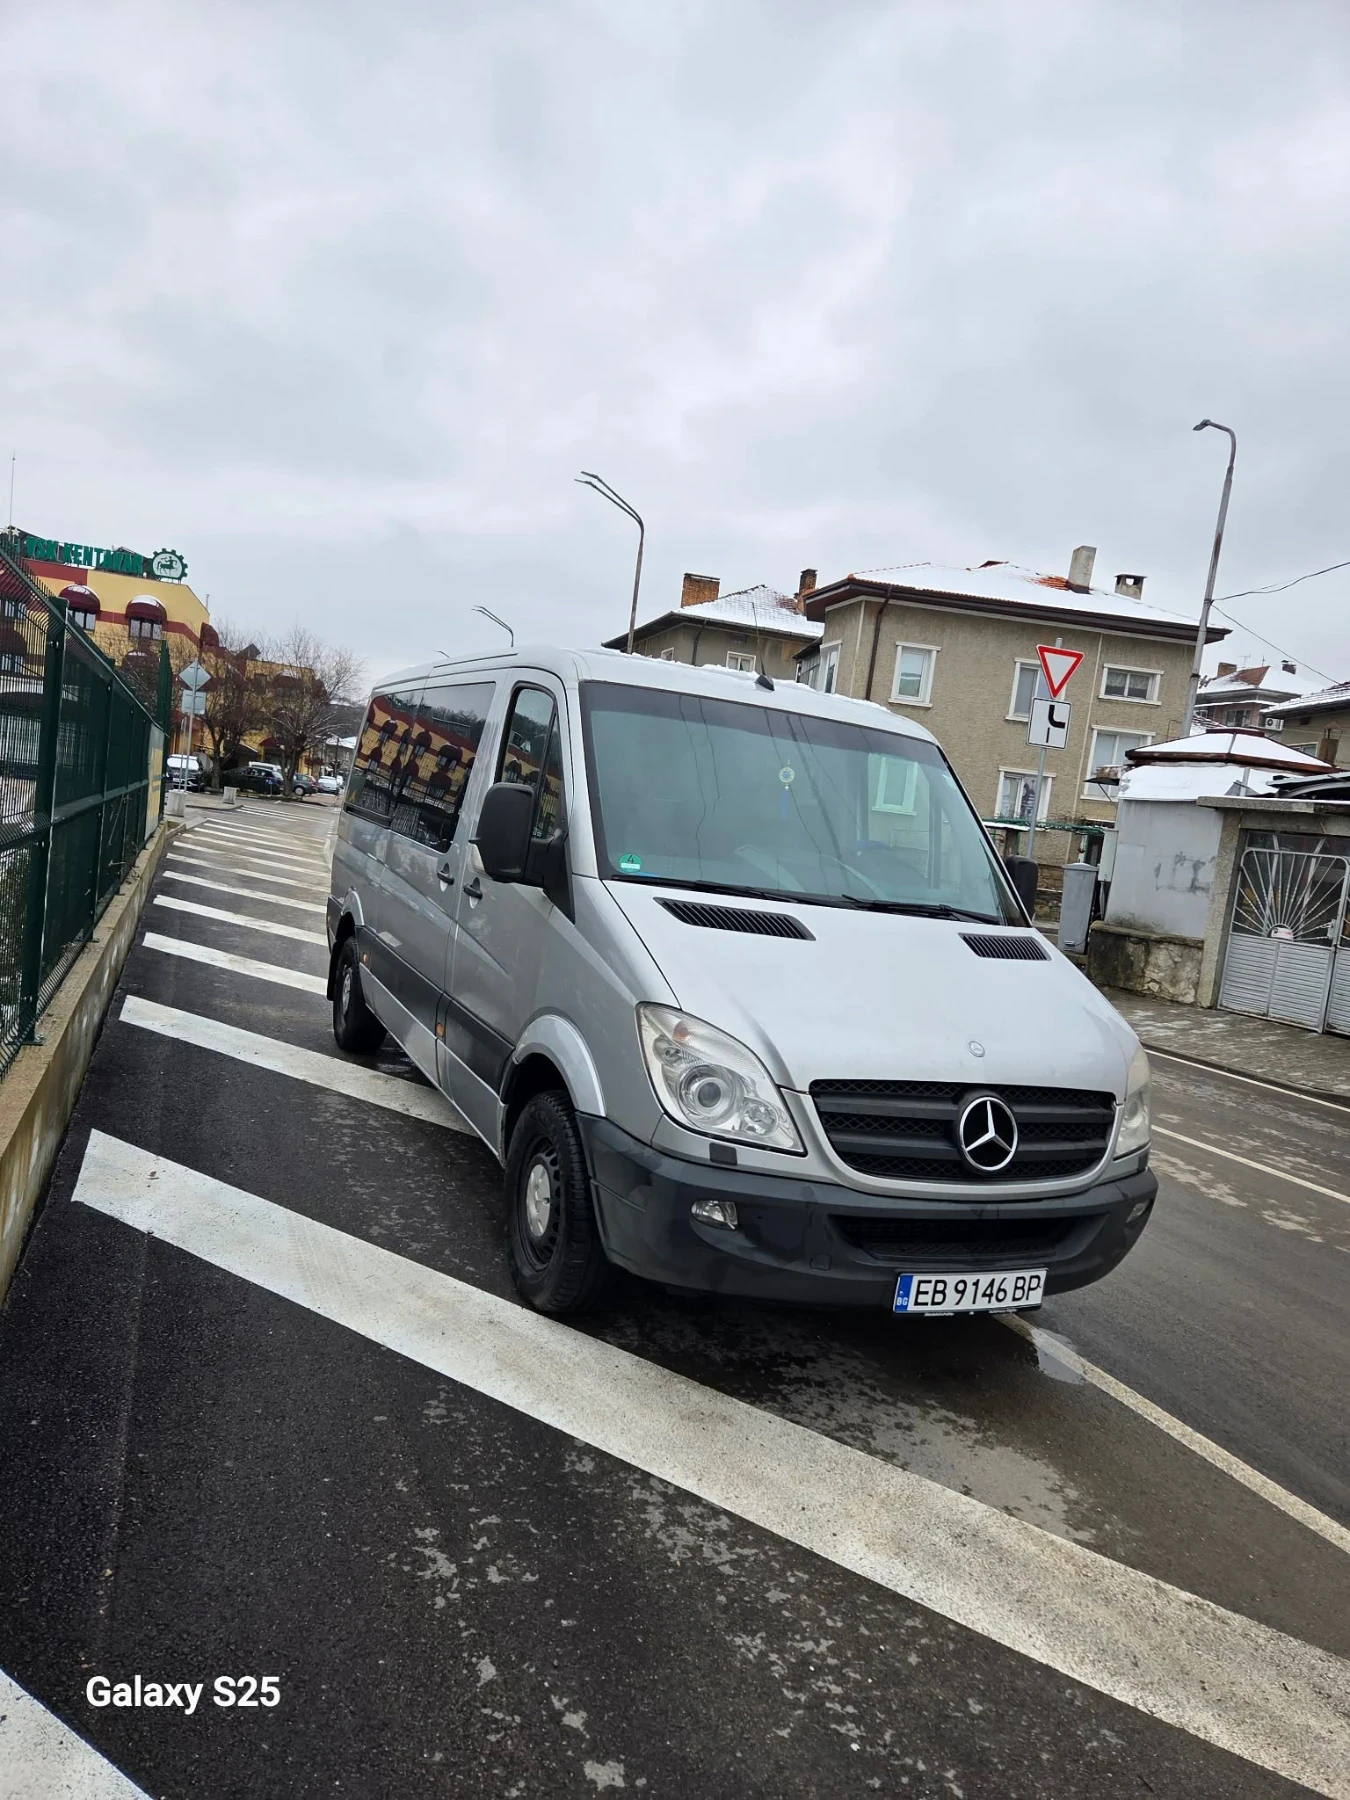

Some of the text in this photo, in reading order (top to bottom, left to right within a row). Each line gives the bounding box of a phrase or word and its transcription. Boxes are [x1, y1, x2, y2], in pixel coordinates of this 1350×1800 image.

[26, 535, 58, 560] VSK
[896, 1296, 909, 1306] BG
[913, 1274, 1042, 1306] EB 9146 BP
